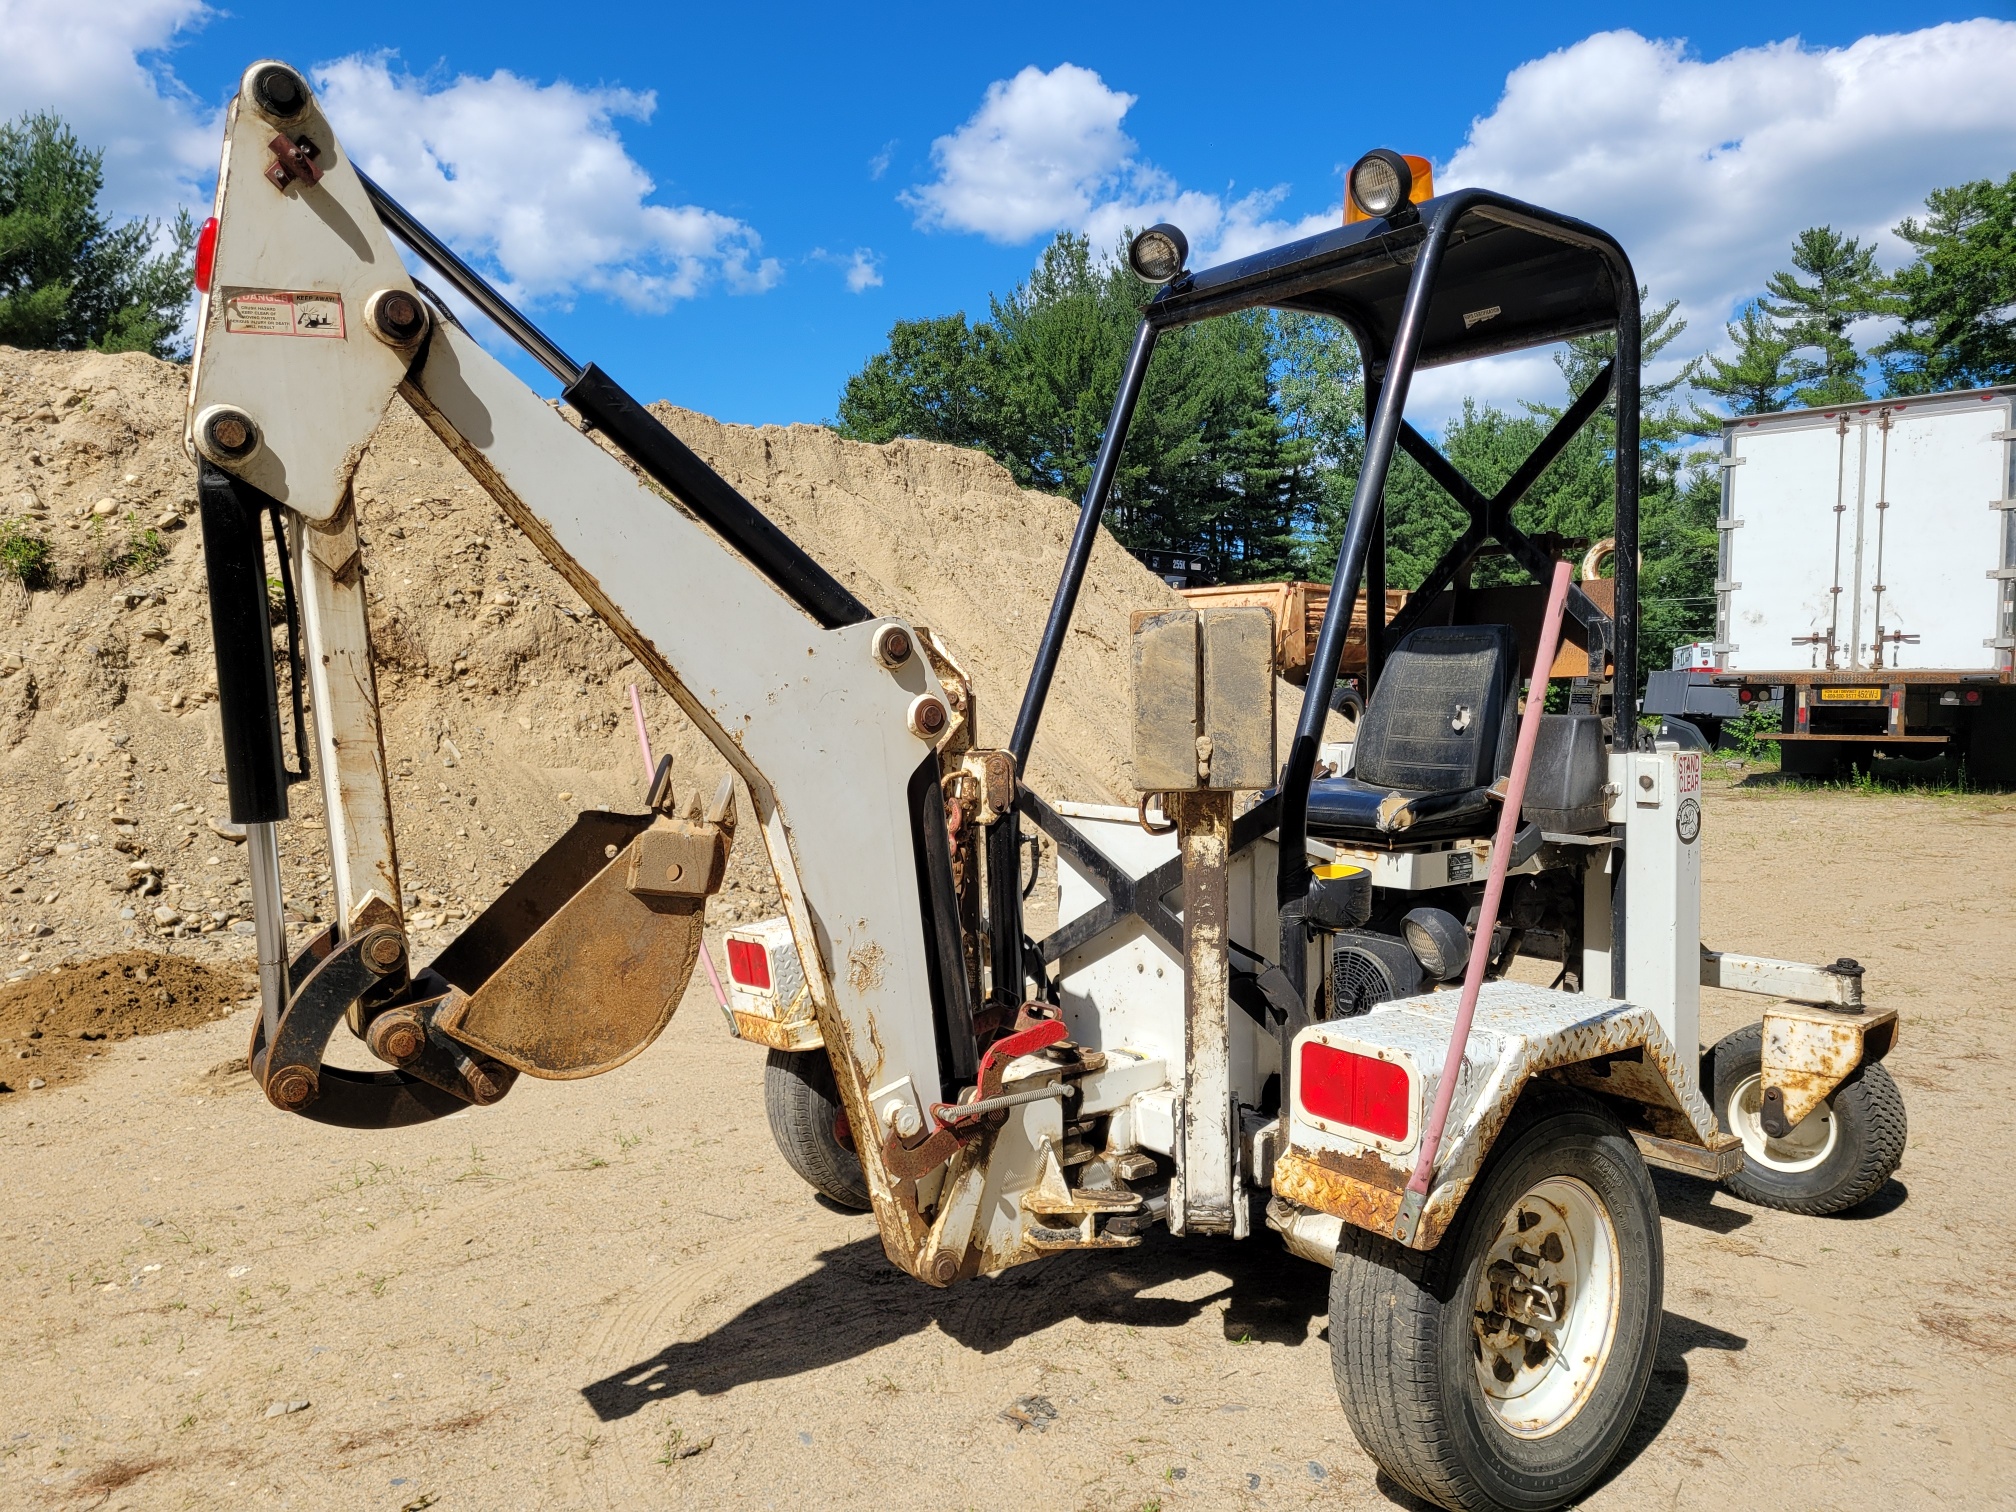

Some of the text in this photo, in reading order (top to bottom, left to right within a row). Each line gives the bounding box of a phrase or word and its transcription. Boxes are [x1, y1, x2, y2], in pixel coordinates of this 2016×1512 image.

[242, 294, 288, 302] DANGER
[1679, 754, 1700, 774] STAND
[1679, 773, 1700, 793] CLEAR
